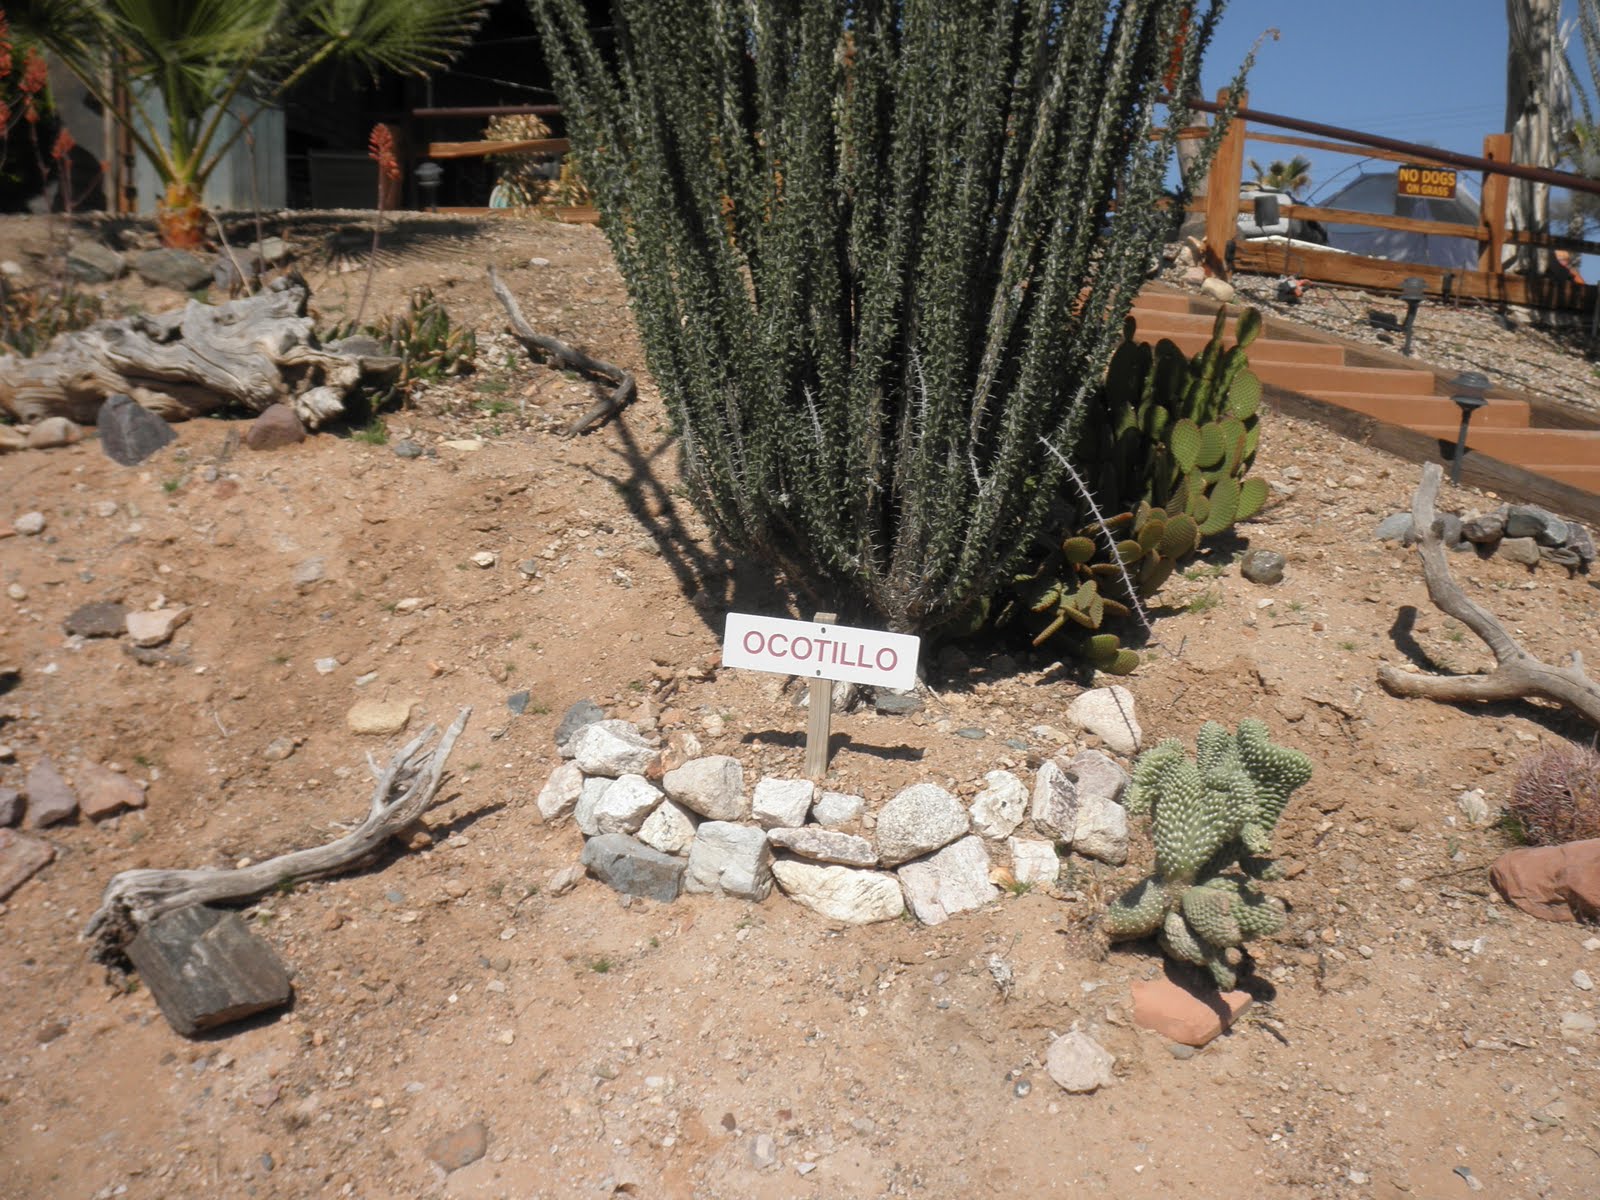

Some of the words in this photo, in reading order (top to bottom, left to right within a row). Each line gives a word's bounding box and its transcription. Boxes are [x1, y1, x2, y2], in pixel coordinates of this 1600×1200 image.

[1400, 168, 1419, 182] NO
[1422, 170, 1456, 186] DOGS
[1406, 183, 1419, 193] ON
[1421, 185, 1449, 196] GRASS
[743, 630, 898, 671] OCOTILLO
